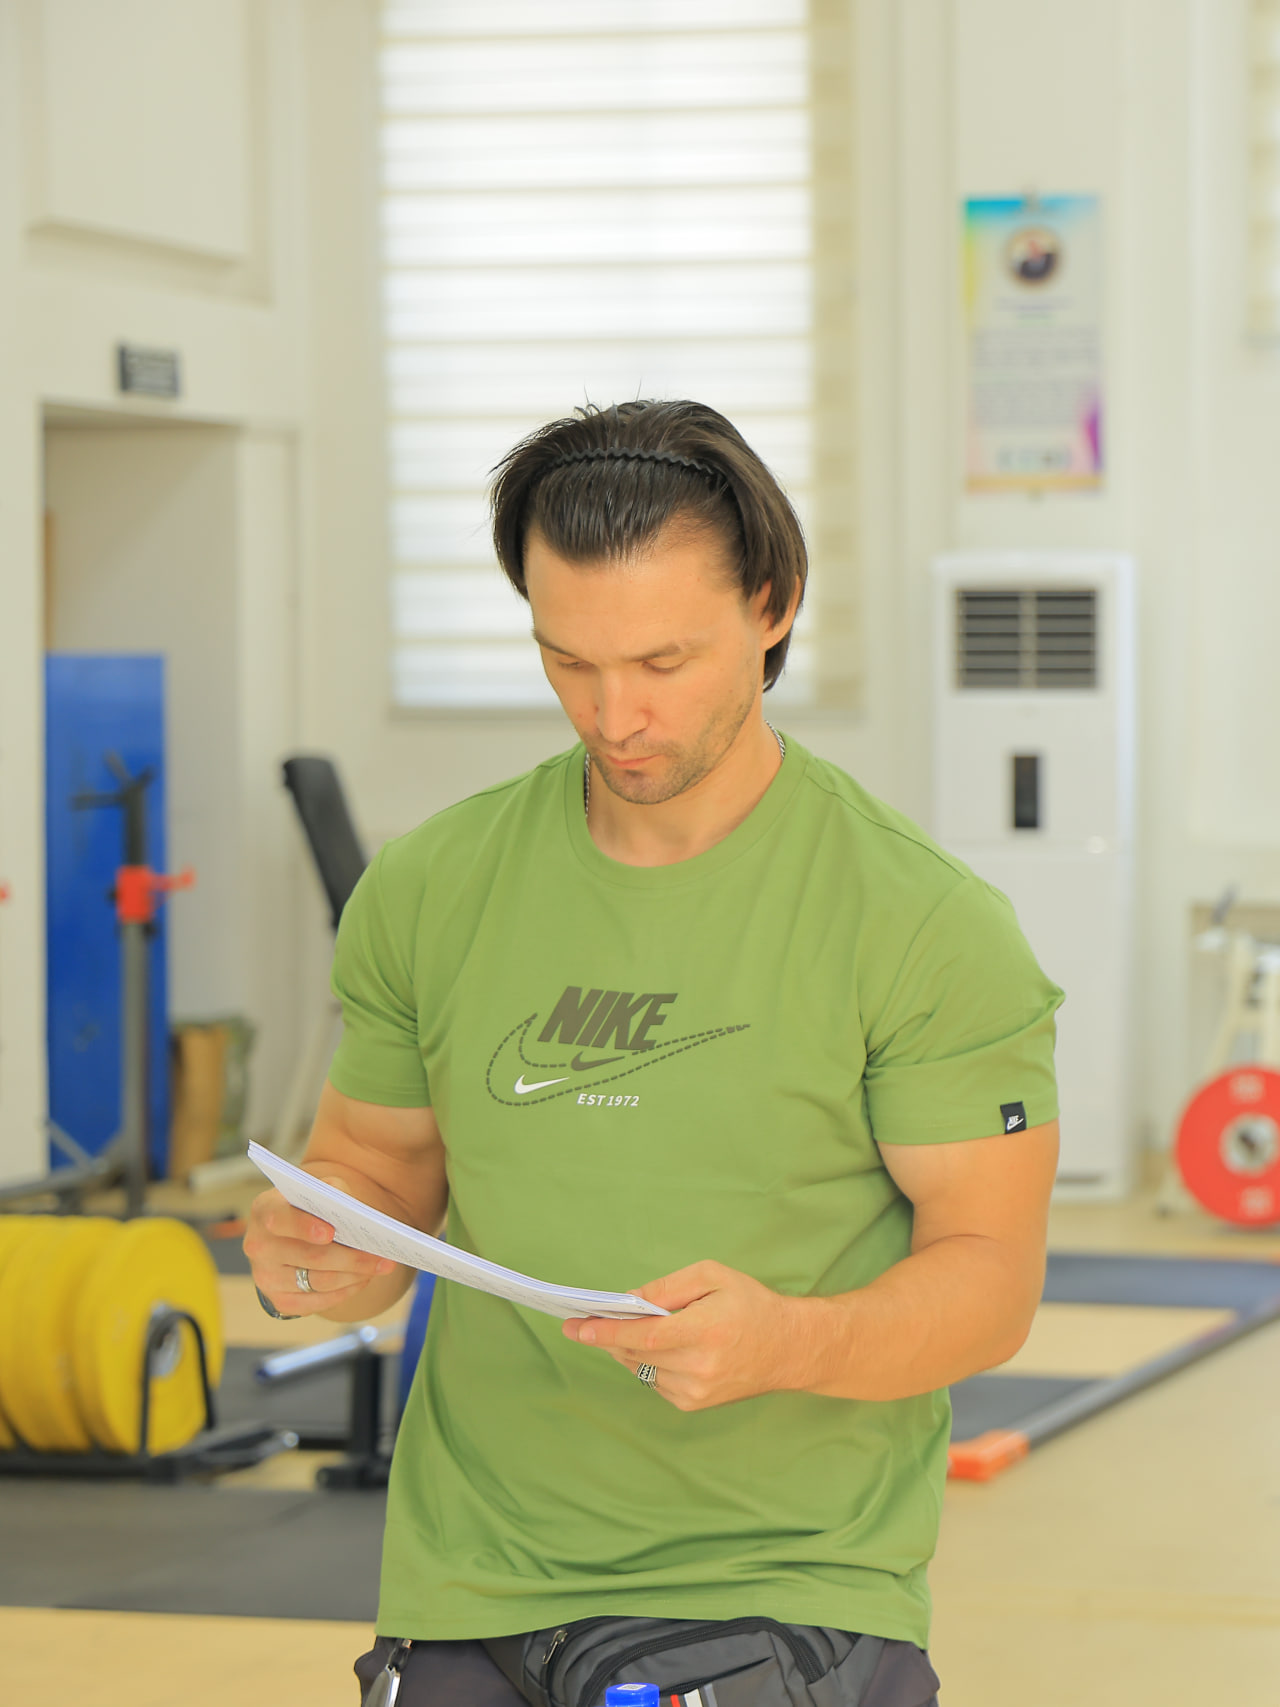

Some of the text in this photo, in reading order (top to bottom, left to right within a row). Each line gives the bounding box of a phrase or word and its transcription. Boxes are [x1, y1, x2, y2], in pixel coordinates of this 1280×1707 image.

[537, 986, 678, 1050] NIKE
[577, 1093, 640, 1107] EST 1972
